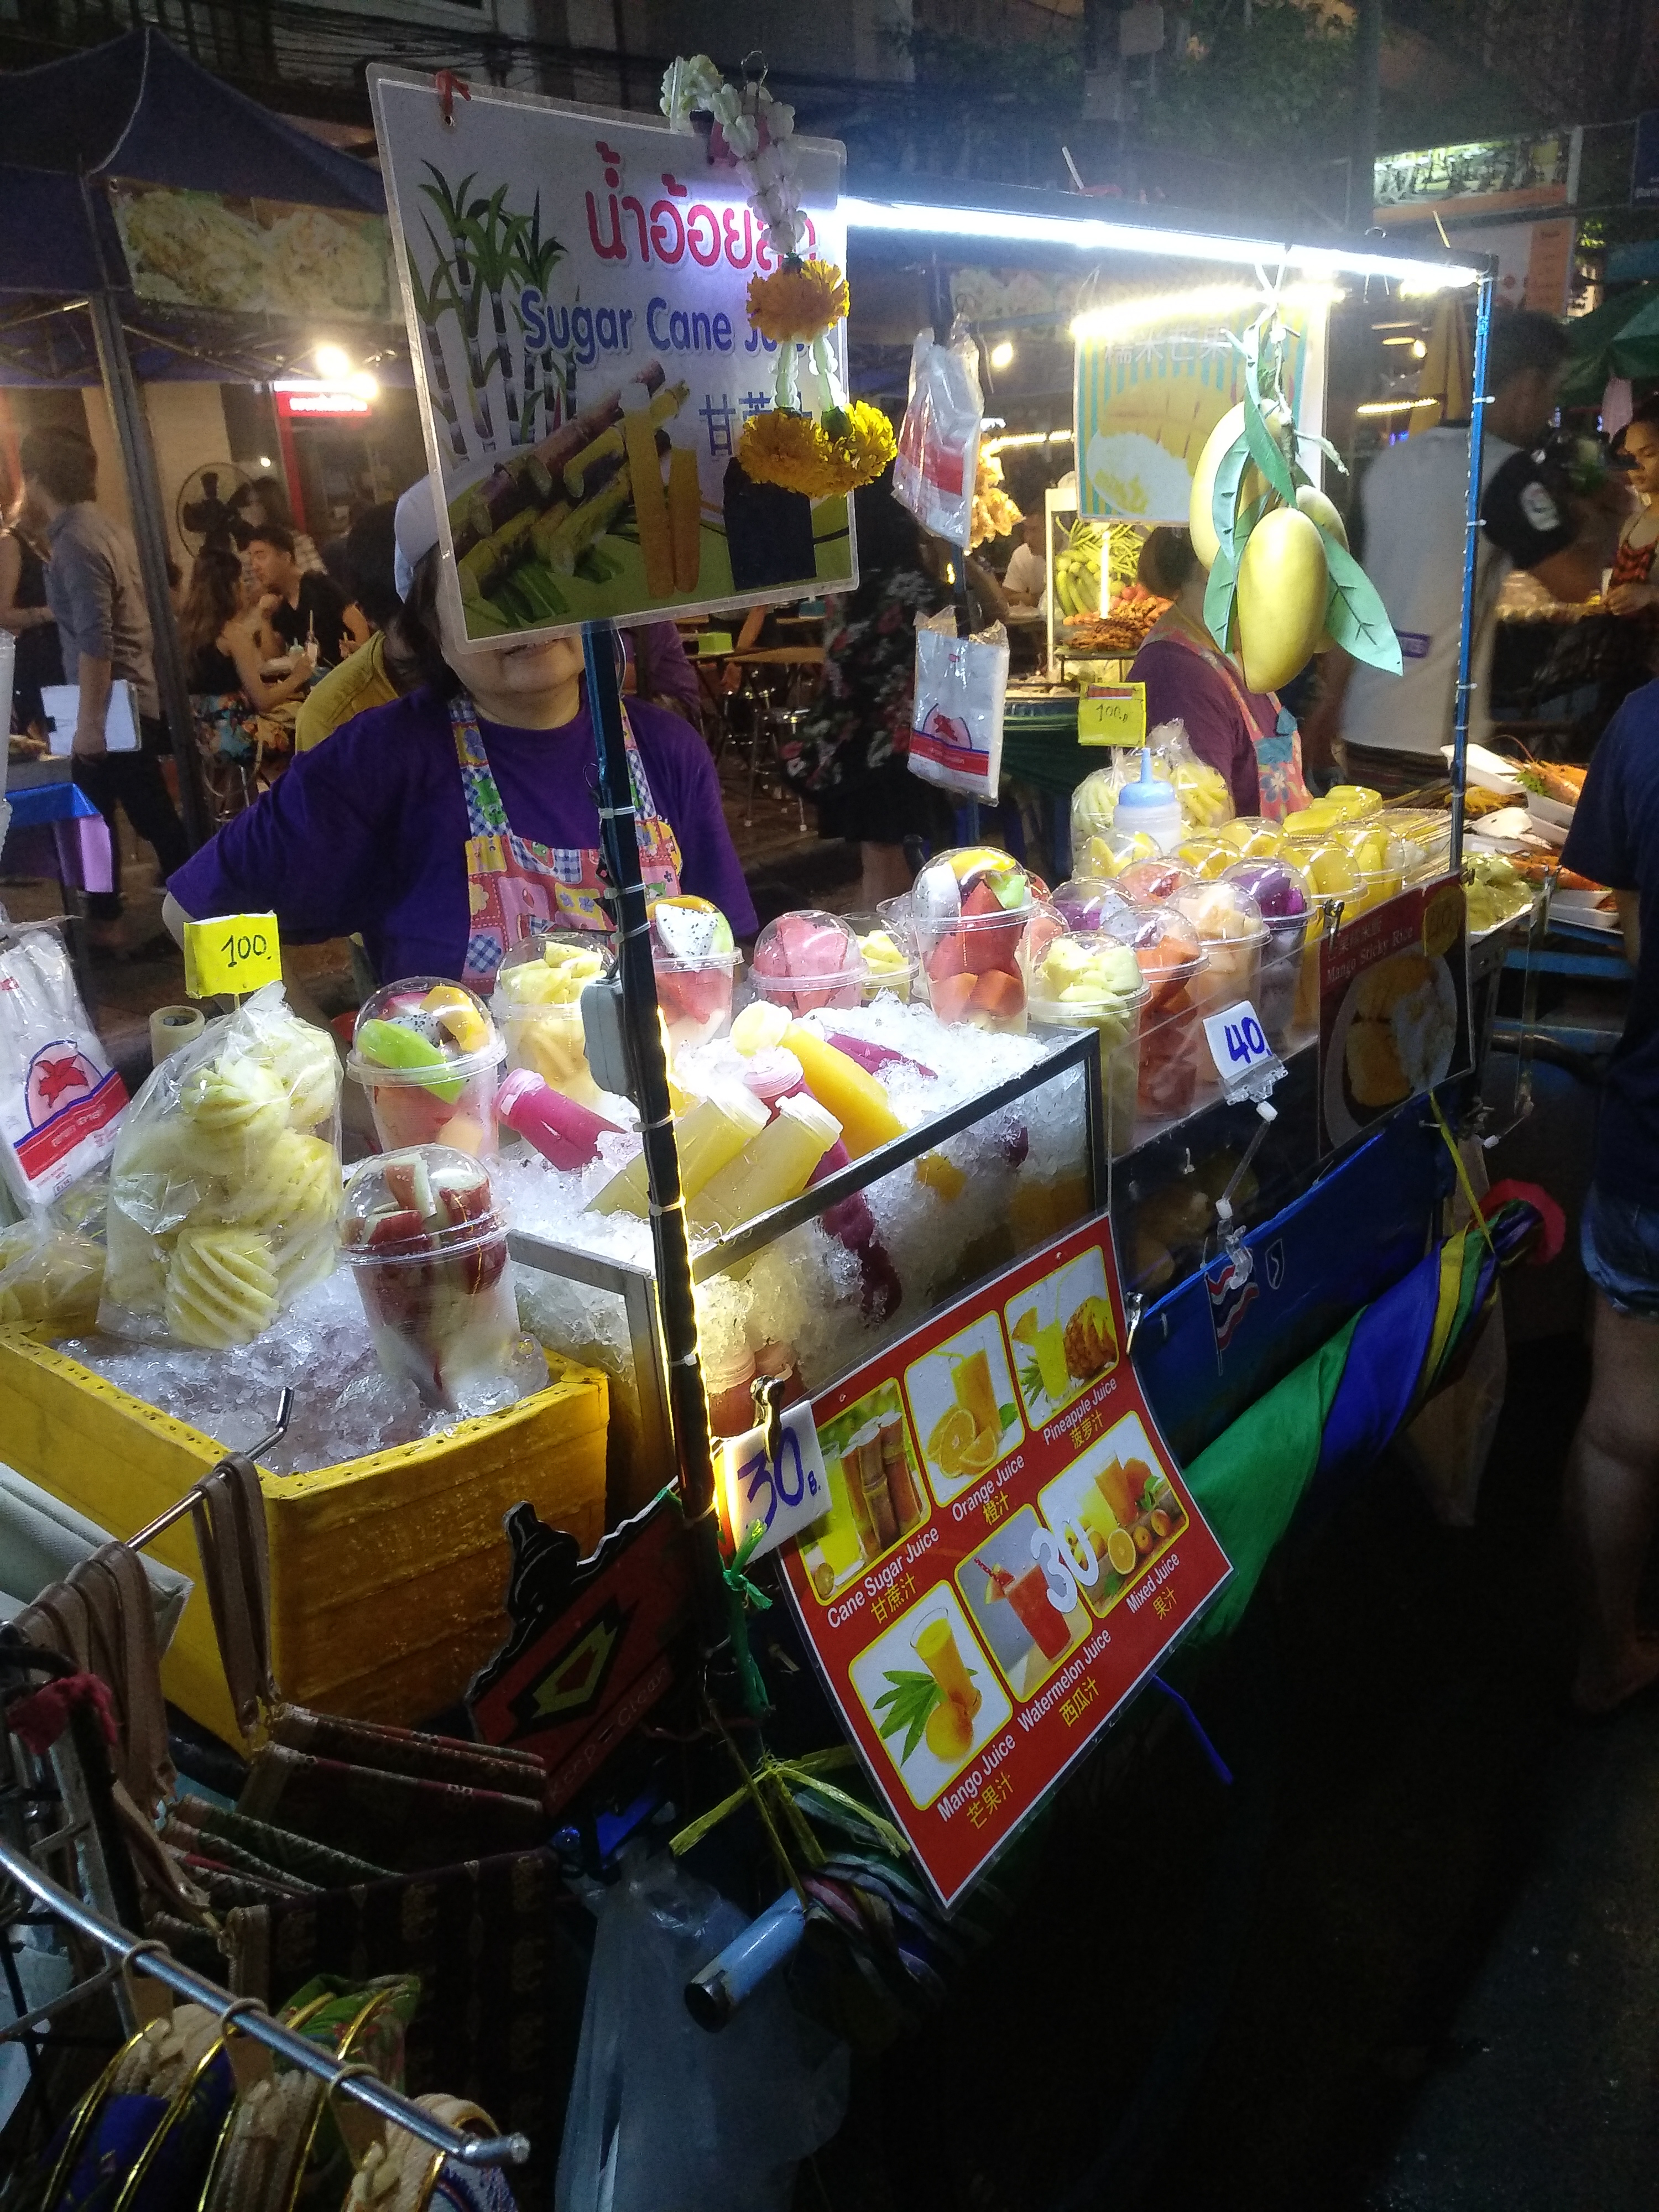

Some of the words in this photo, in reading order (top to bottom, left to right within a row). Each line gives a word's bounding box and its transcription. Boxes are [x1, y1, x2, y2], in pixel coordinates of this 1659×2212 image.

[521, 289, 632, 364] Sugar
[646, 296, 732, 351] Cane
[1327, 958, 1356, 983] Mango
[1360, 938, 1389, 964] Sticky
[1392, 926, 1413, 947] Rice
[1043, 1399, 1092, 1446] Pineapple
[1092, 1378, 1117, 1406] Juice
[1069, 1409, 1103, 1449] 菠萝汁
[952, 1480, 995, 1521] Orange
[996, 1455, 1025, 1486] Juice
[983, 1490, 1009, 1526] 橙汁
[827, 1590, 865, 1628] Cane
[864, 1556, 903, 1597] Sugar
[906, 1527, 939, 1564] Juice
[1030, 1509, 1100, 1614] 30
[1126, 1574, 1157, 1614] Mixed
[1154, 1553, 1180, 1584] Juice
[870, 1572, 916, 1625] 甘蔗汁
[1152, 1587, 1177, 1620] 果汁
[1017, 1659, 1086, 1732] Watermelon
[1083, 1630, 1112, 1665] Juice
[1058, 1676, 1099, 1728] 西瓜汁
[937, 1770, 983, 1822] Mango
[981, 1734, 1016, 1776] Juice
[967, 1771, 1014, 1829] 芒果汁
